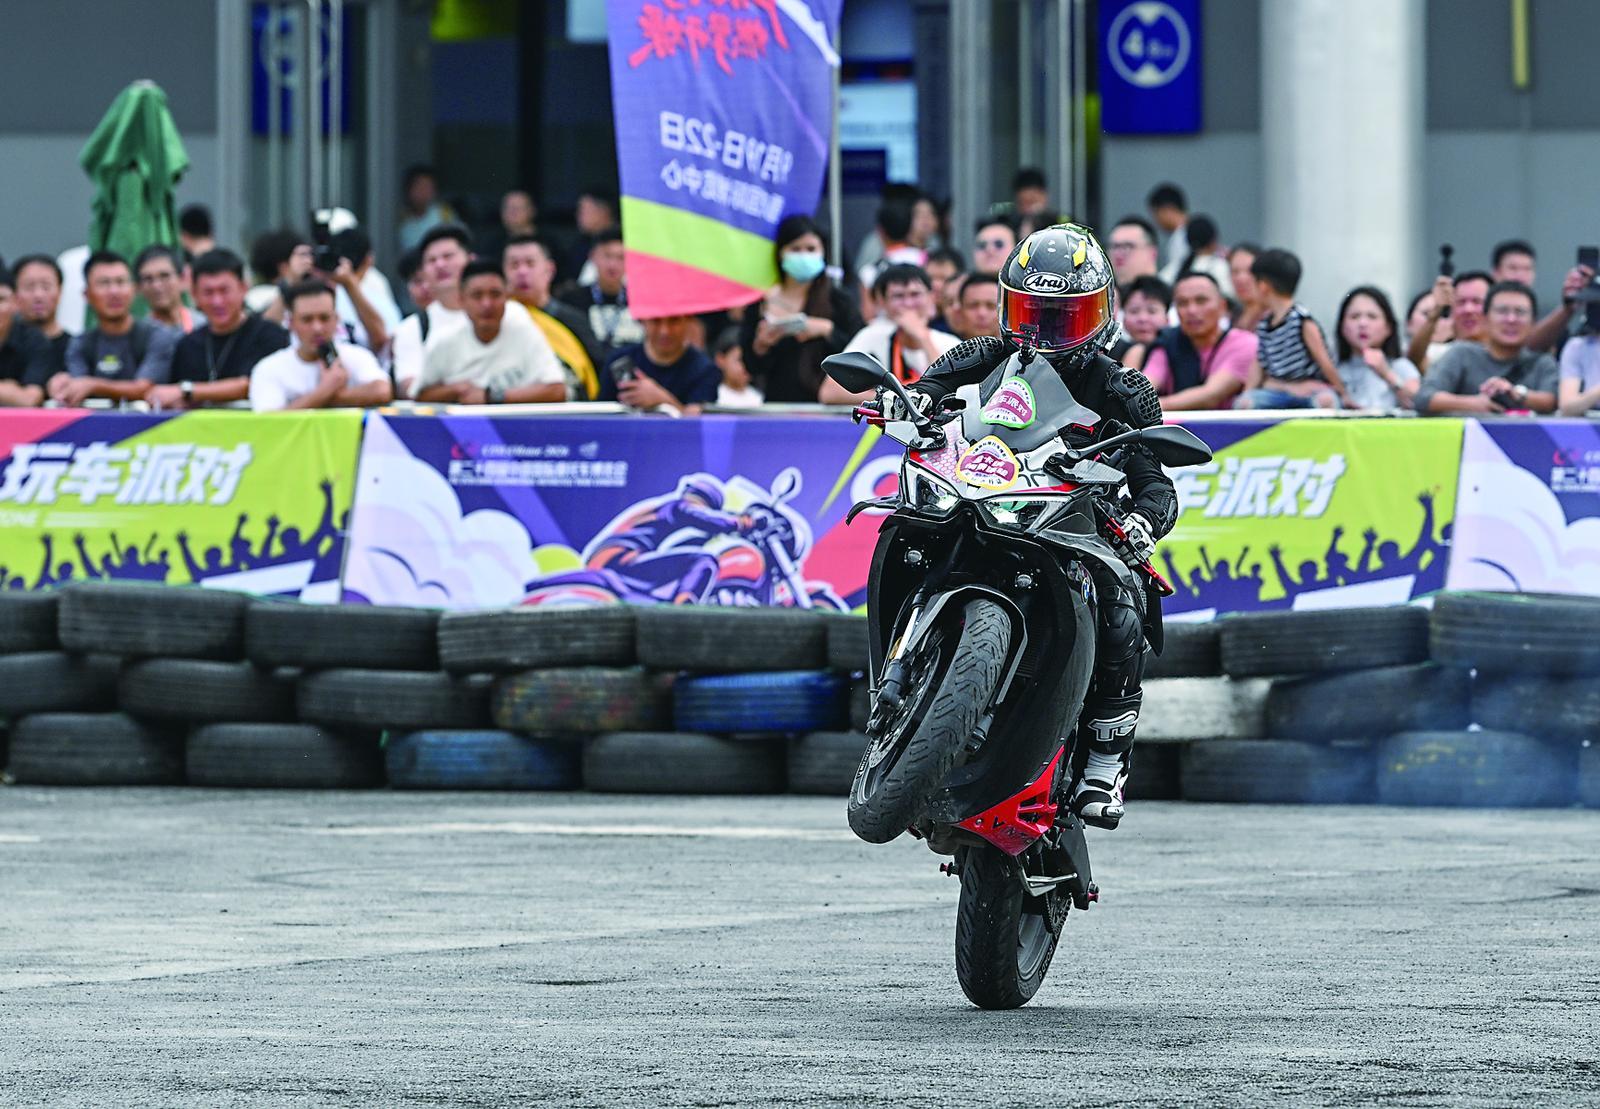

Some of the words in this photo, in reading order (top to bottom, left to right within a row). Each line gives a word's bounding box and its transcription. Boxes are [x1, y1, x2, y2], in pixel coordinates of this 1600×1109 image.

[1026, 275, 1064, 289] Arai
[0, 441, 253, 505] 玩车派对
